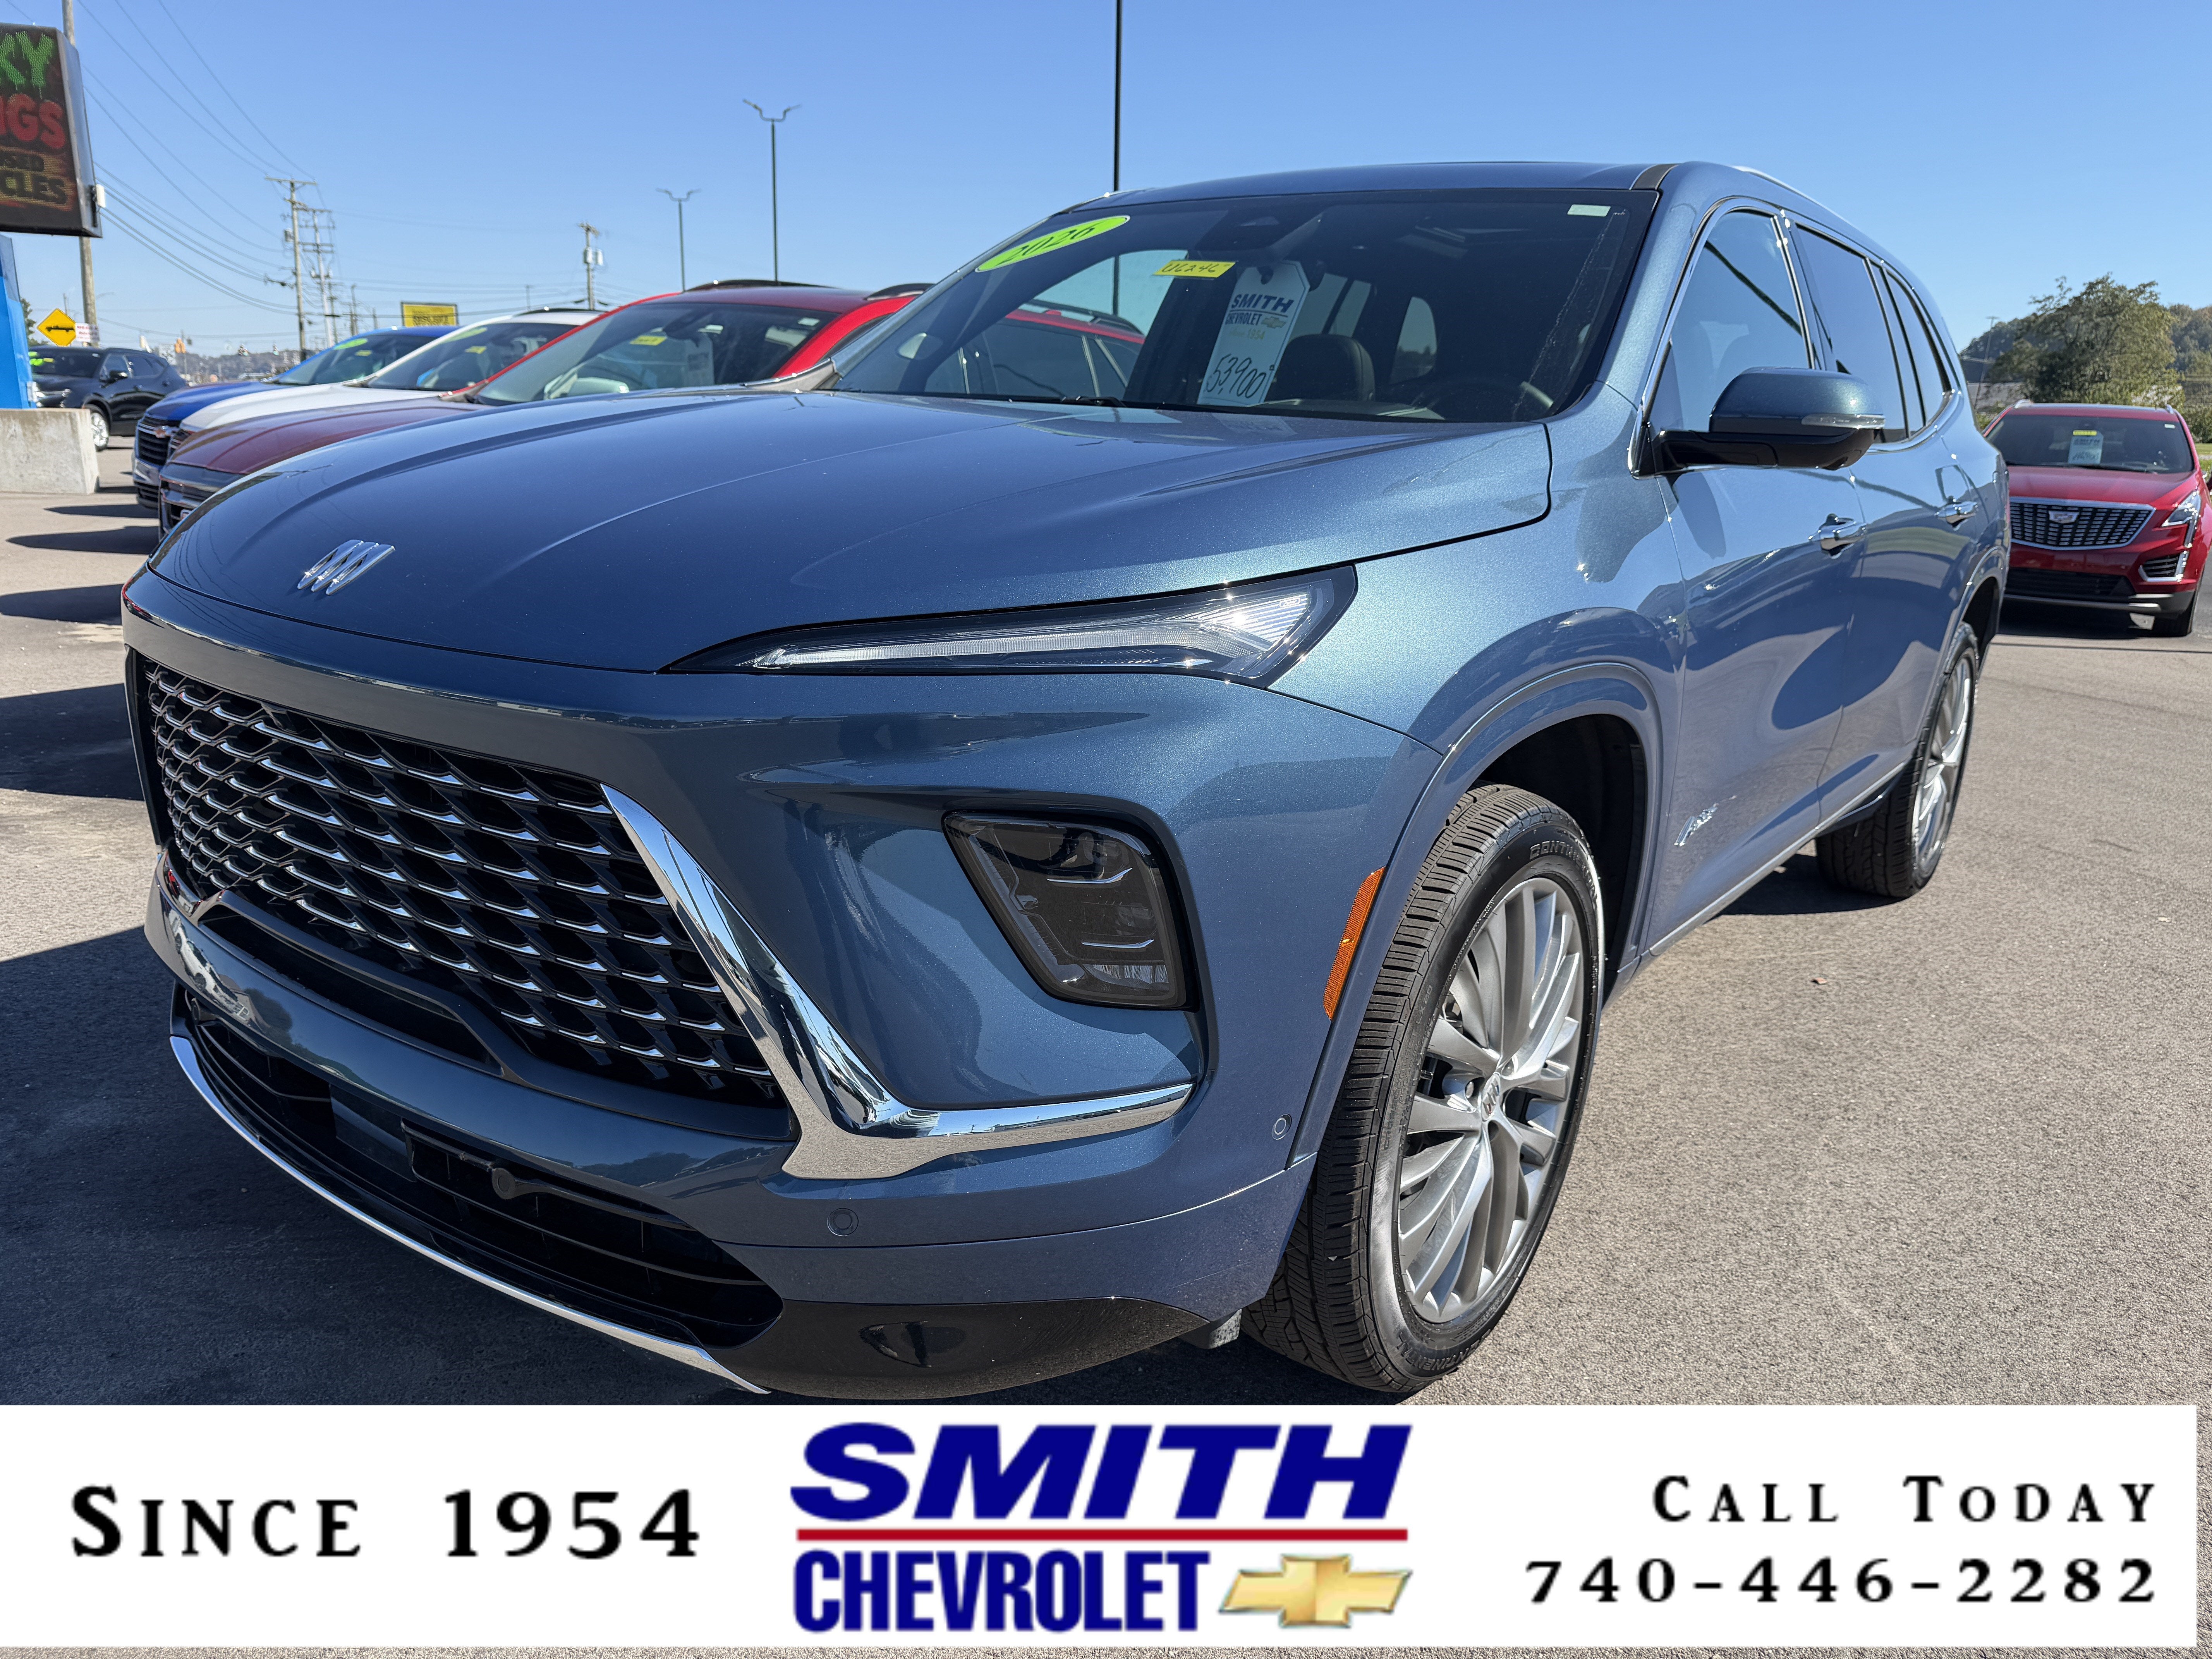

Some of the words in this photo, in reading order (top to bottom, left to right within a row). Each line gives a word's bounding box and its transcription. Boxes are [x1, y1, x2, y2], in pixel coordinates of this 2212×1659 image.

[1231, 294, 1294, 313] SMITH
[1225, 312, 1262, 326] CHEVROLET
[1247, 328, 1266, 340] 1954
